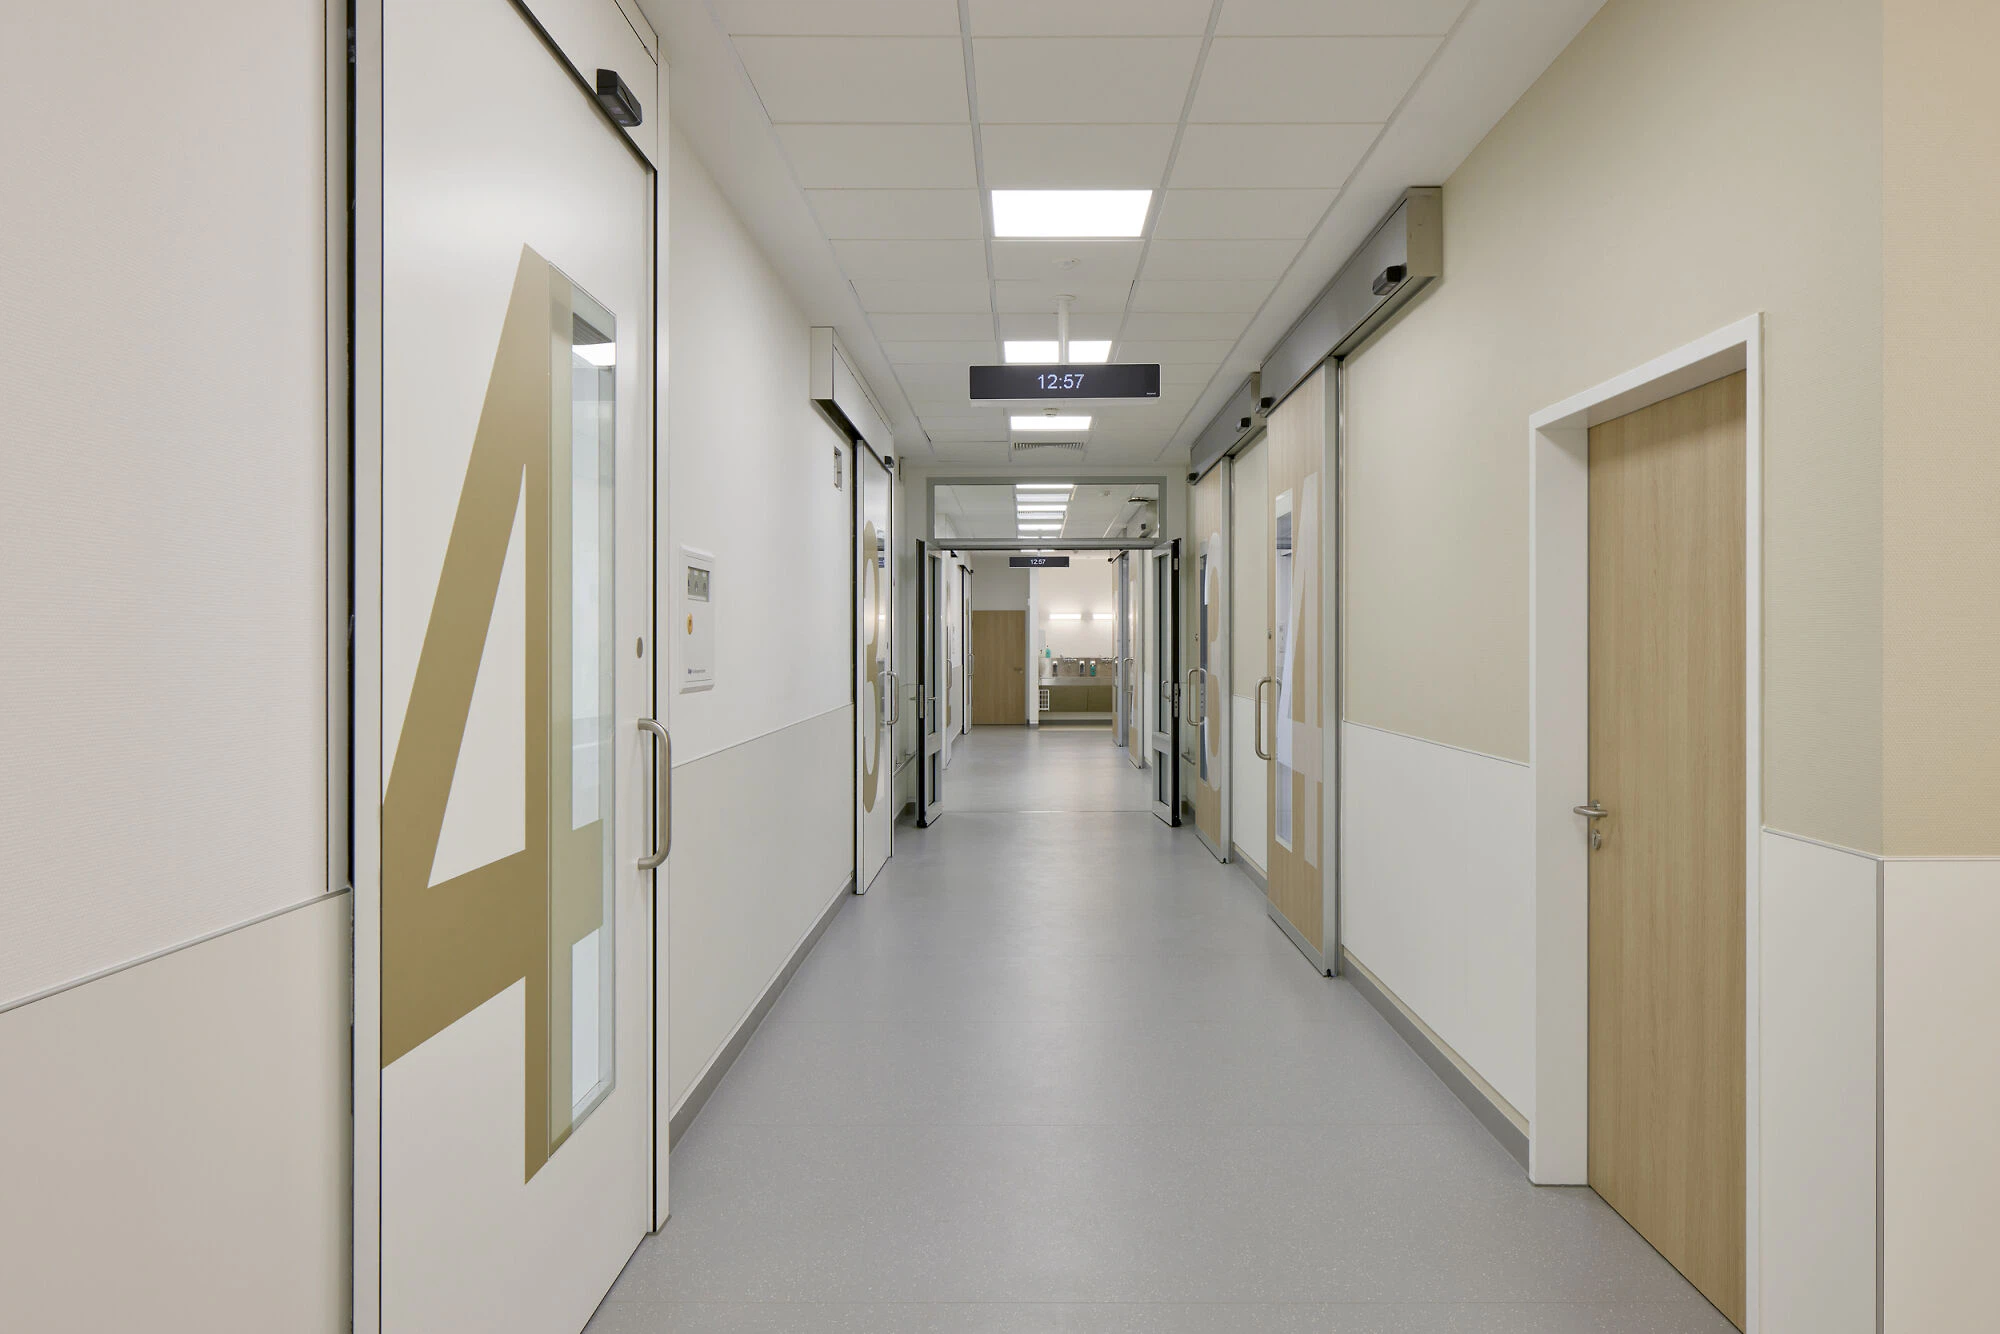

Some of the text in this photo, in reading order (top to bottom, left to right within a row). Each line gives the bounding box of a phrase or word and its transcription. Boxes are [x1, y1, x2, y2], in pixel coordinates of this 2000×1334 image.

[1037, 374, 1085, 390] 12:57
[382, 242, 603, 1184] 4
[864, 520, 880, 813] 3
[1277, 472, 1322, 869] 4
